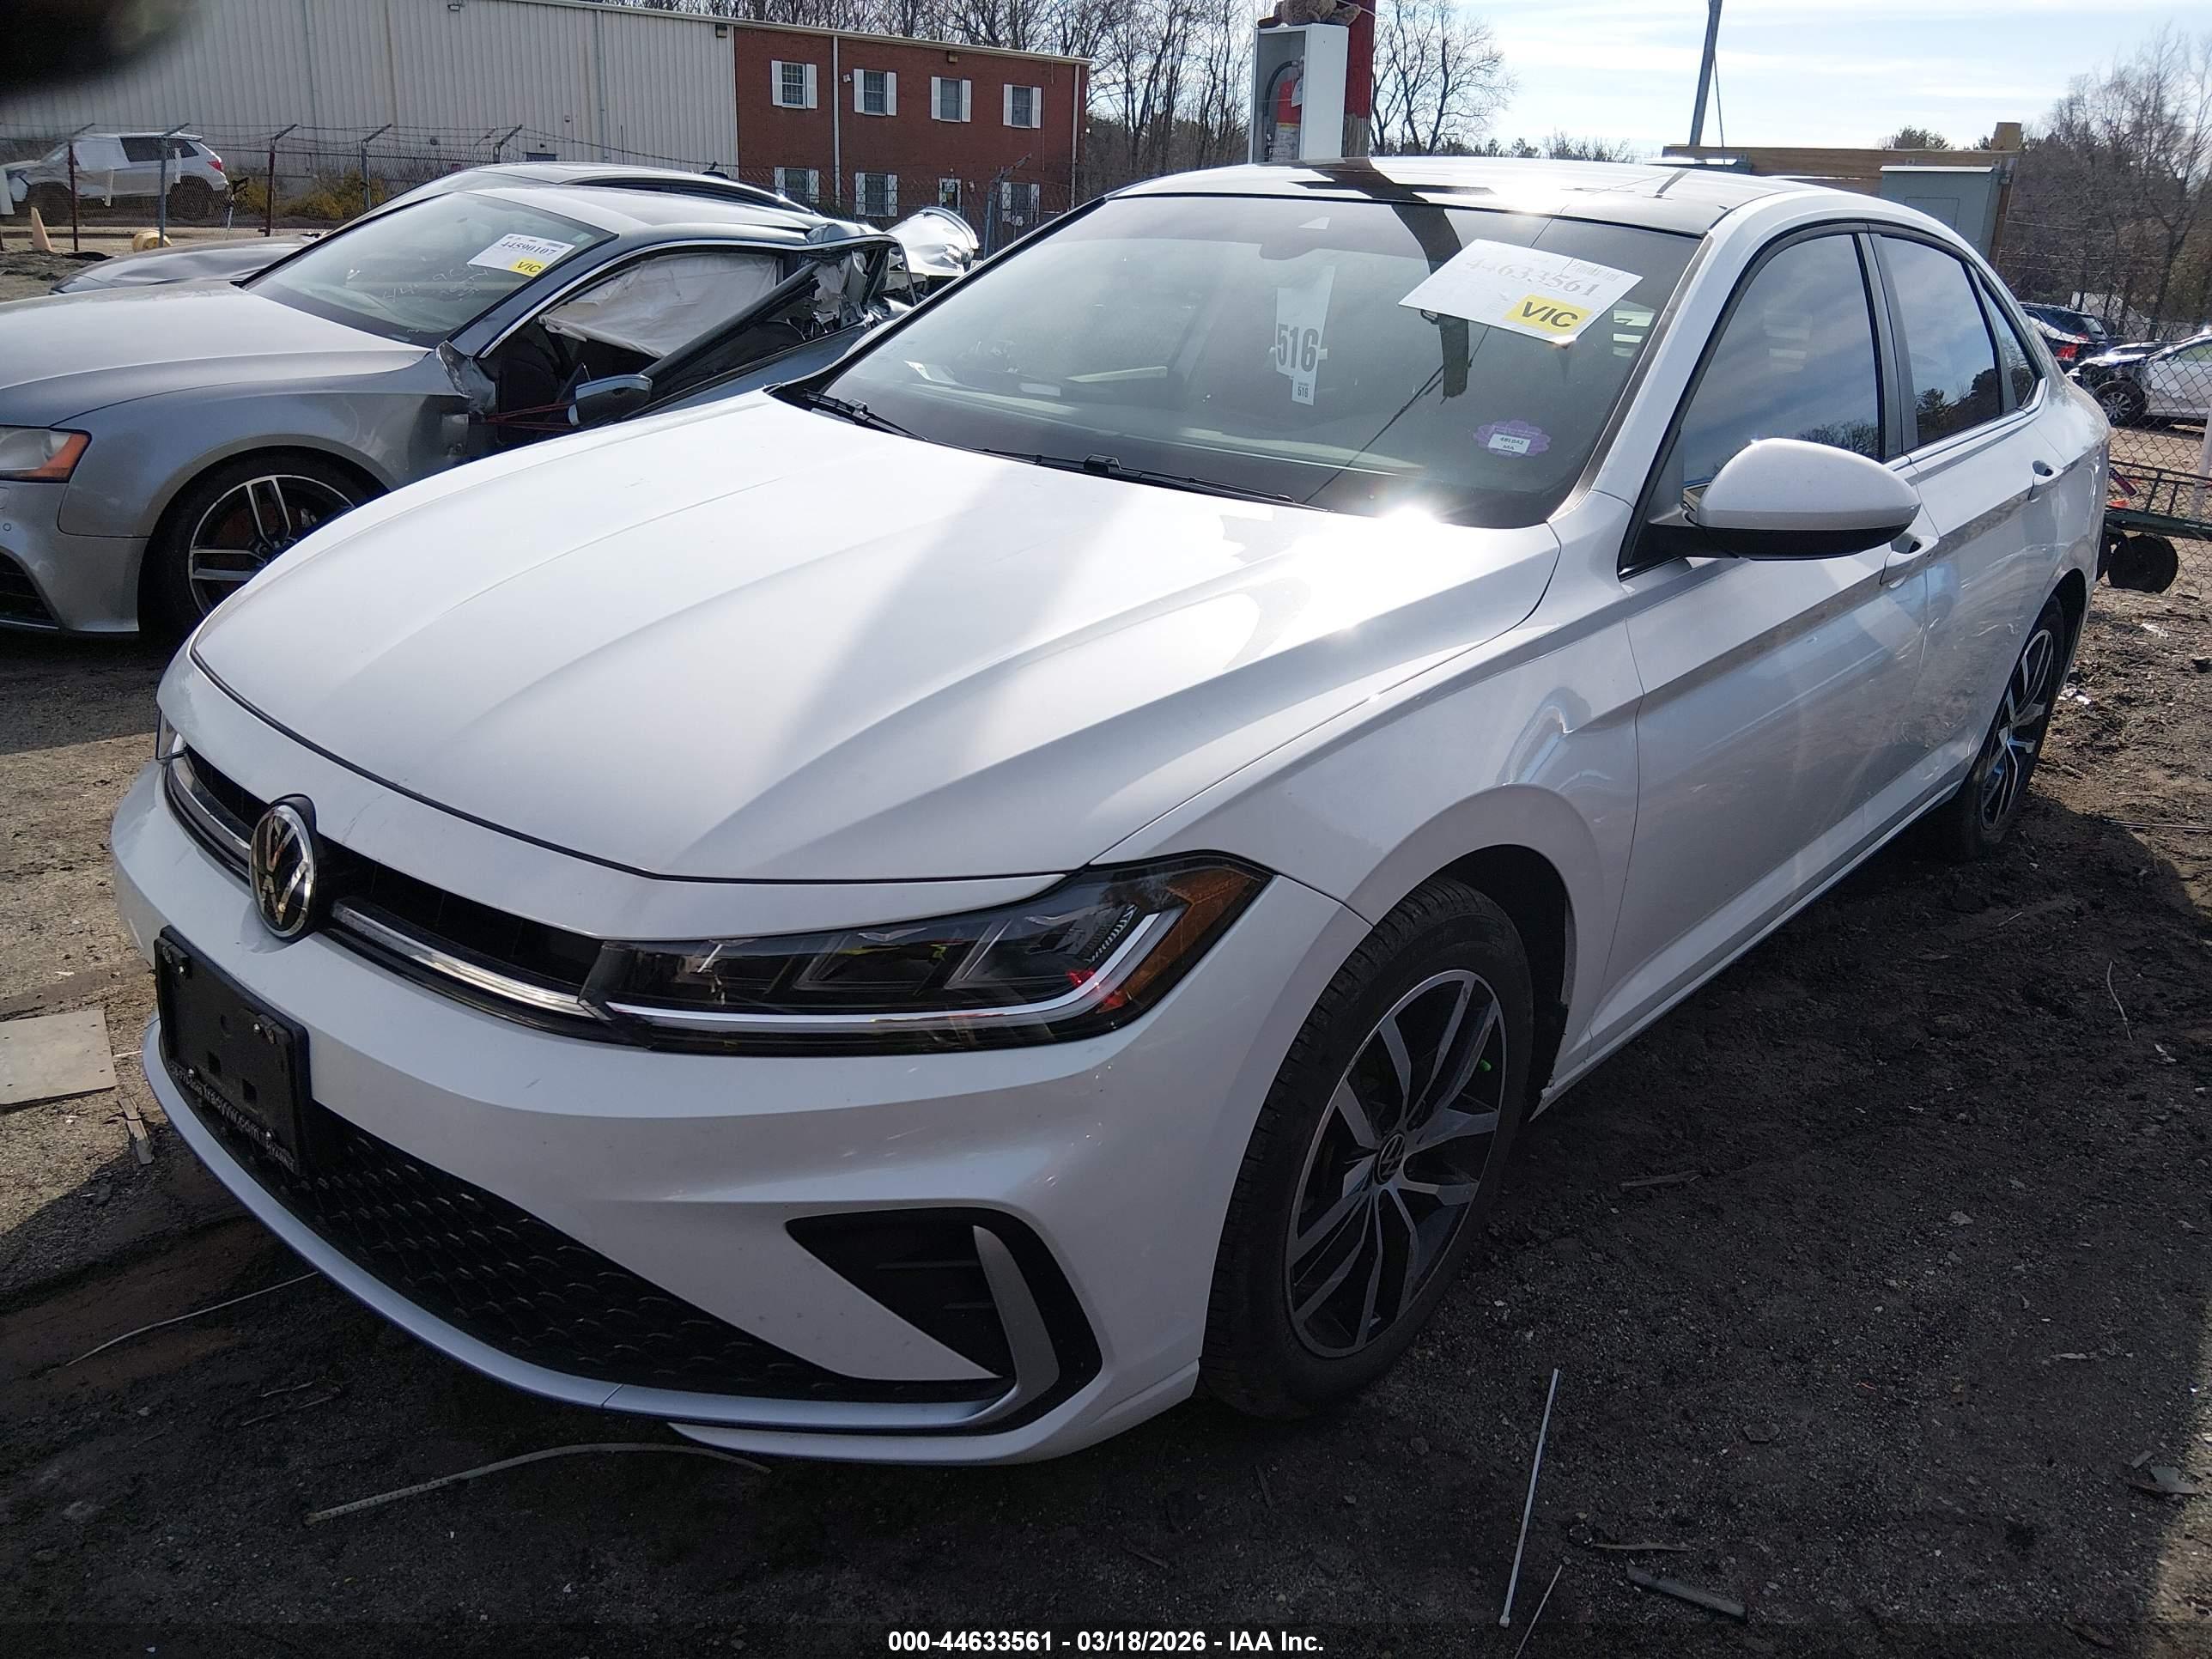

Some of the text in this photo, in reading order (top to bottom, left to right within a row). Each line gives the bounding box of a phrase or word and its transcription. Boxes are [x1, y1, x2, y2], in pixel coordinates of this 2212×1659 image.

[517, 261, 542, 273] VIC
[1520, 301, 1579, 328] VIC
[1277, 323, 1319, 373] 516
[1297, 386, 1309, 398] 516
